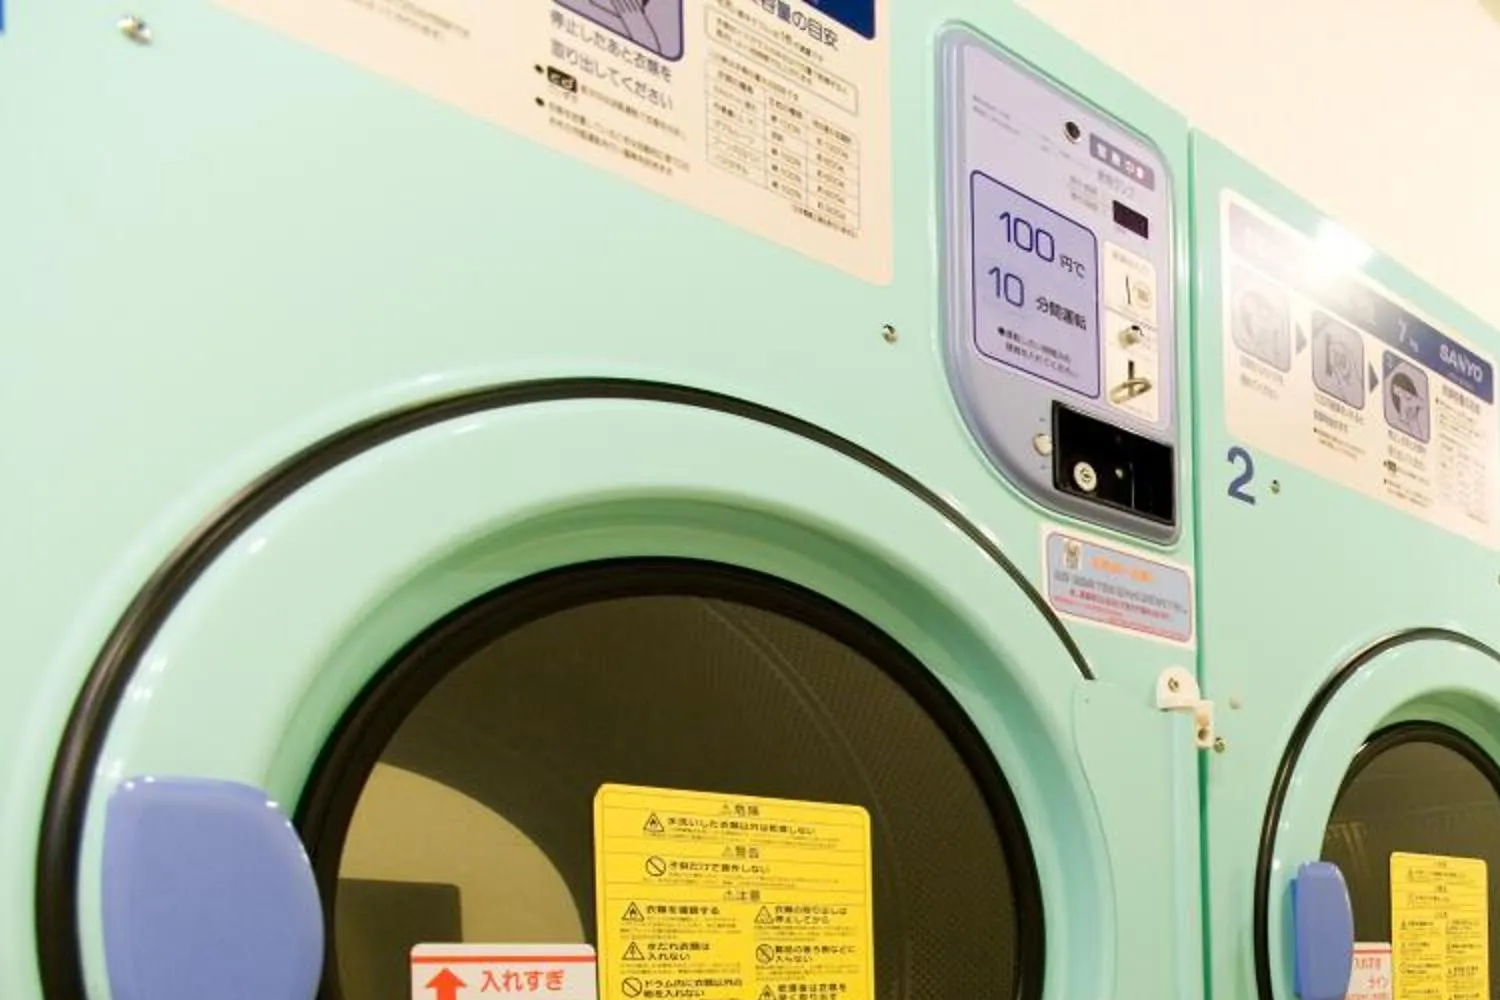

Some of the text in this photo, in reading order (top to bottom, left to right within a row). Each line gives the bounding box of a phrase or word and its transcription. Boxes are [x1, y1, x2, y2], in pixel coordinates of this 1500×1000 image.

[999, 212, 1055, 262] 100
[988, 266, 1025, 307] 10
[1439, 343, 1483, 382] SANYO
[1227, 446, 1256, 505] 2
[480, 969, 565, 993] 入れすぎ
